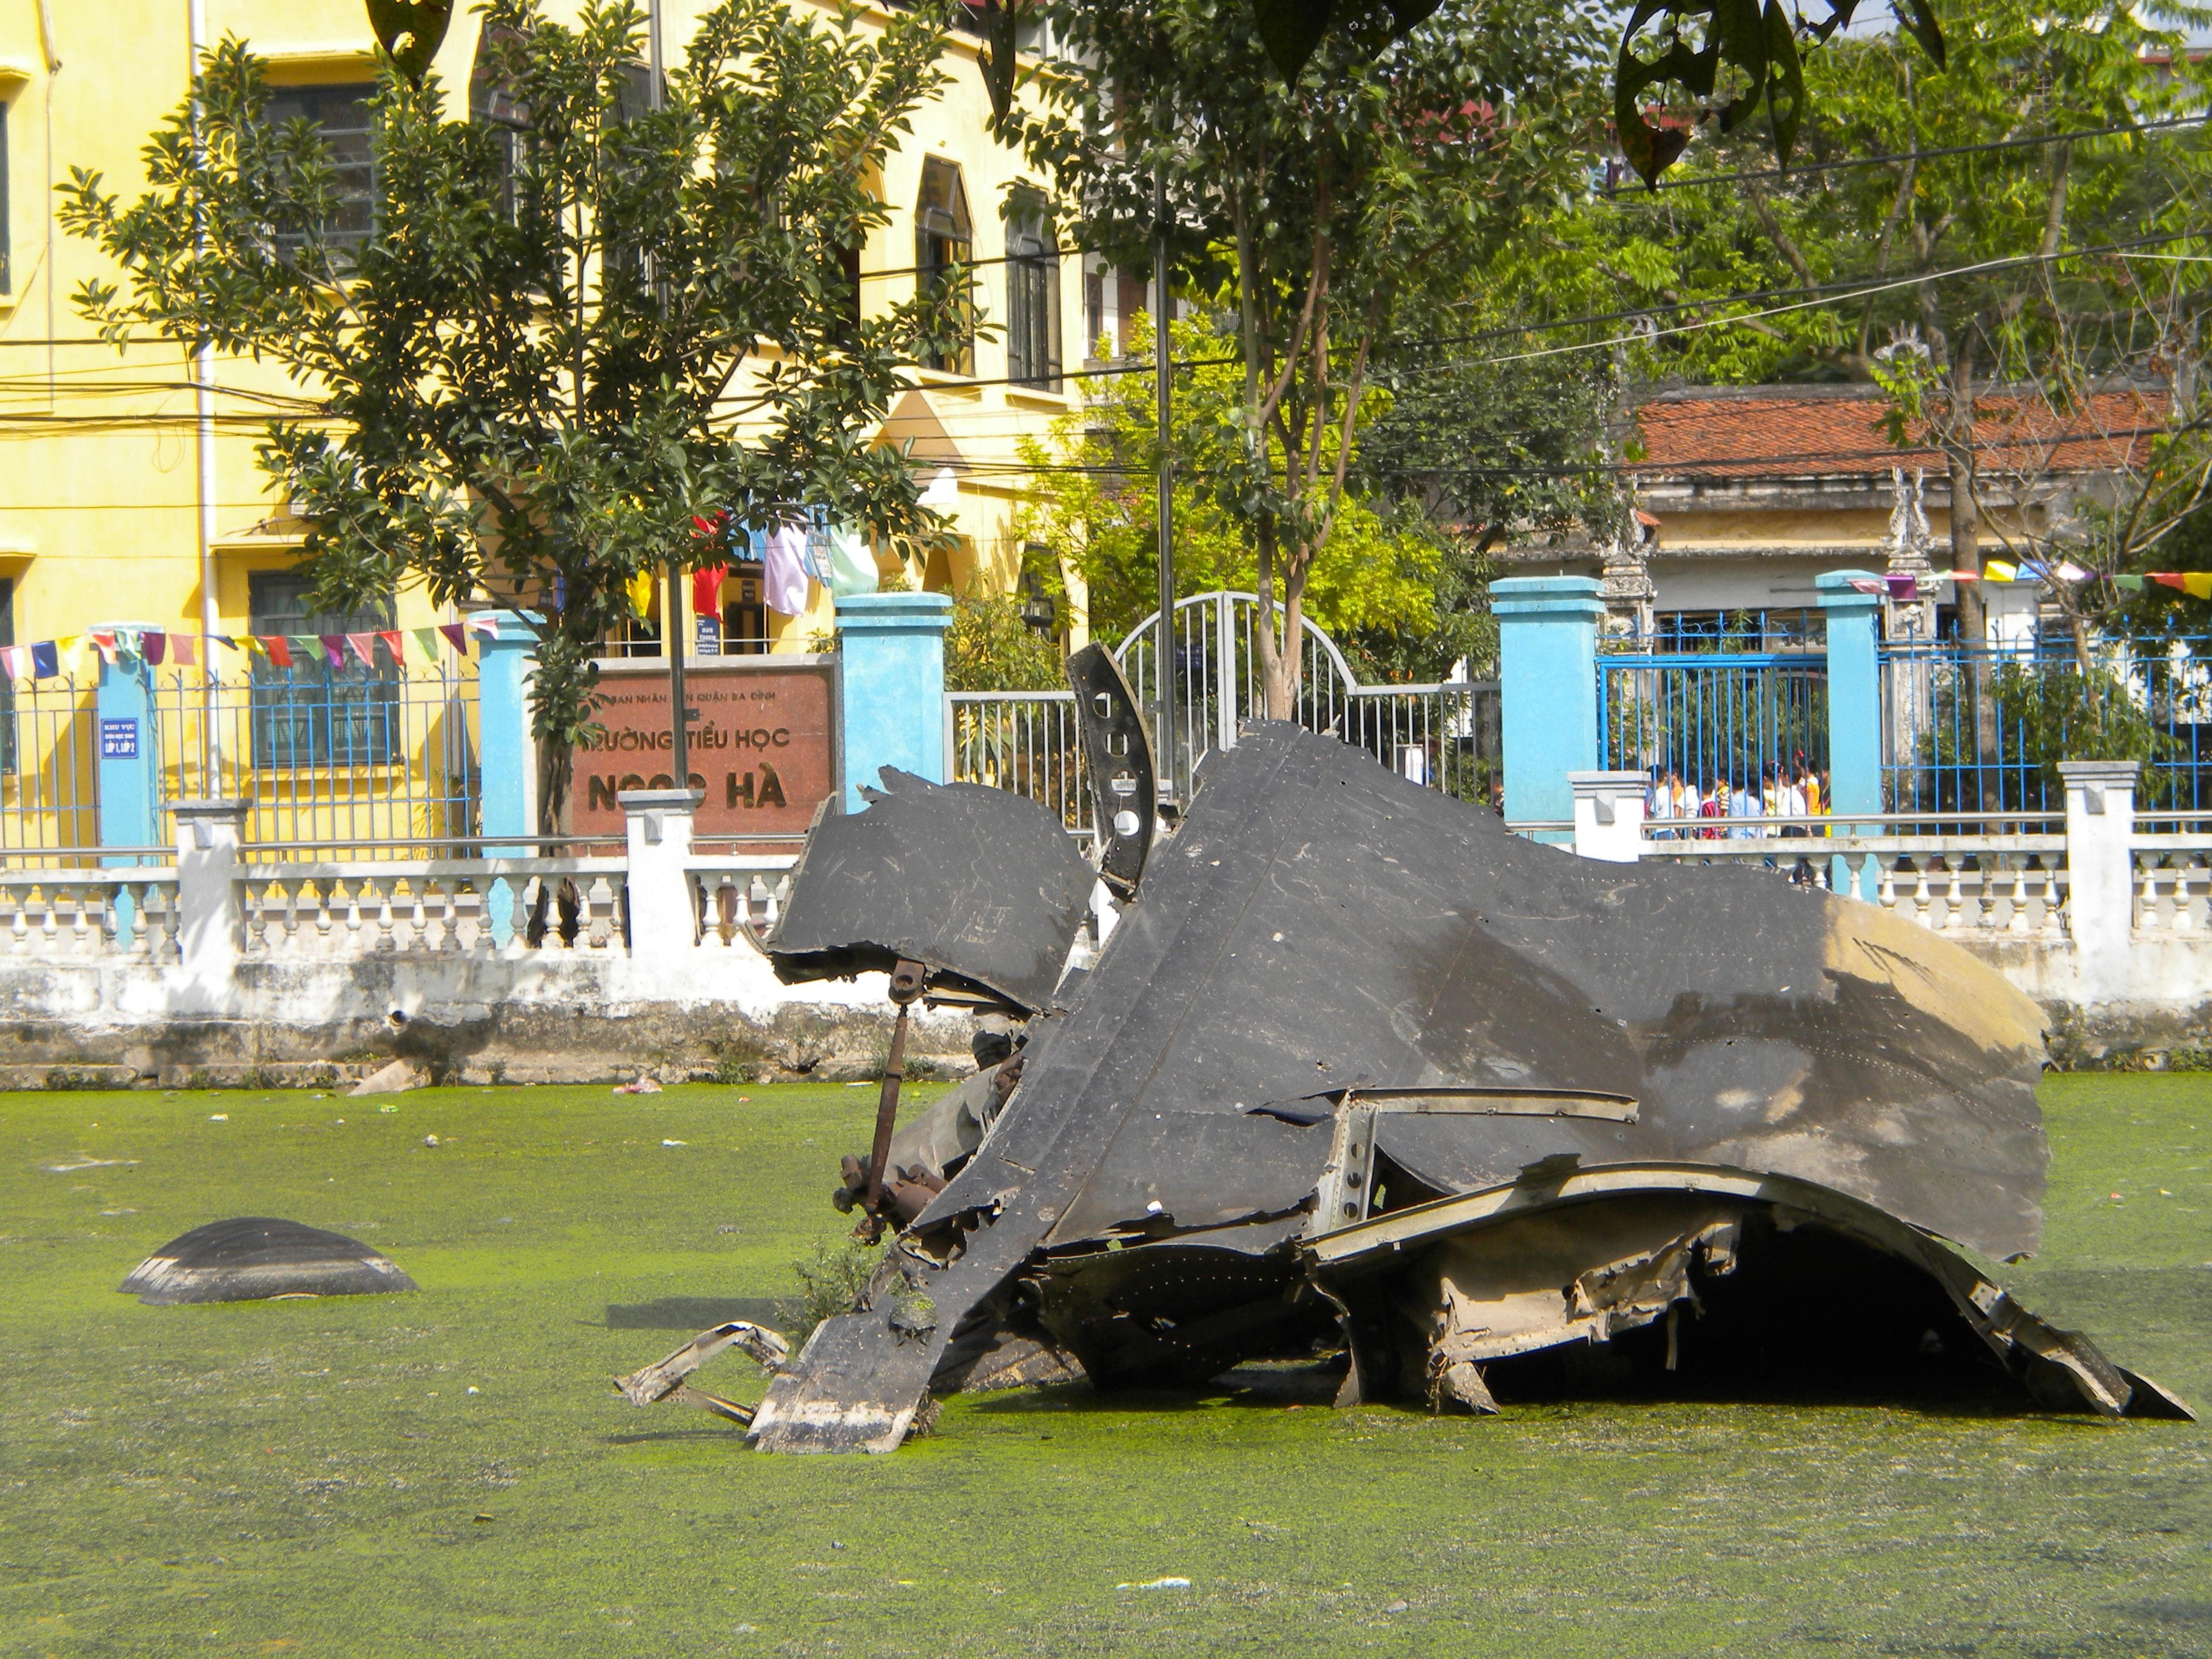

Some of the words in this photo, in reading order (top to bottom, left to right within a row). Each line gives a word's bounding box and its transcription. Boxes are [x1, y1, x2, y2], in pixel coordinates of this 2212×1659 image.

[637, 692, 666, 703] NHÂN
[697, 691, 728, 703] QUẬN
[731, 692, 746, 702] BA
[582, 726, 673, 752] RƯỜNG
[735, 728, 790, 752] HỌC
[726, 762, 787, 809] HÀ
